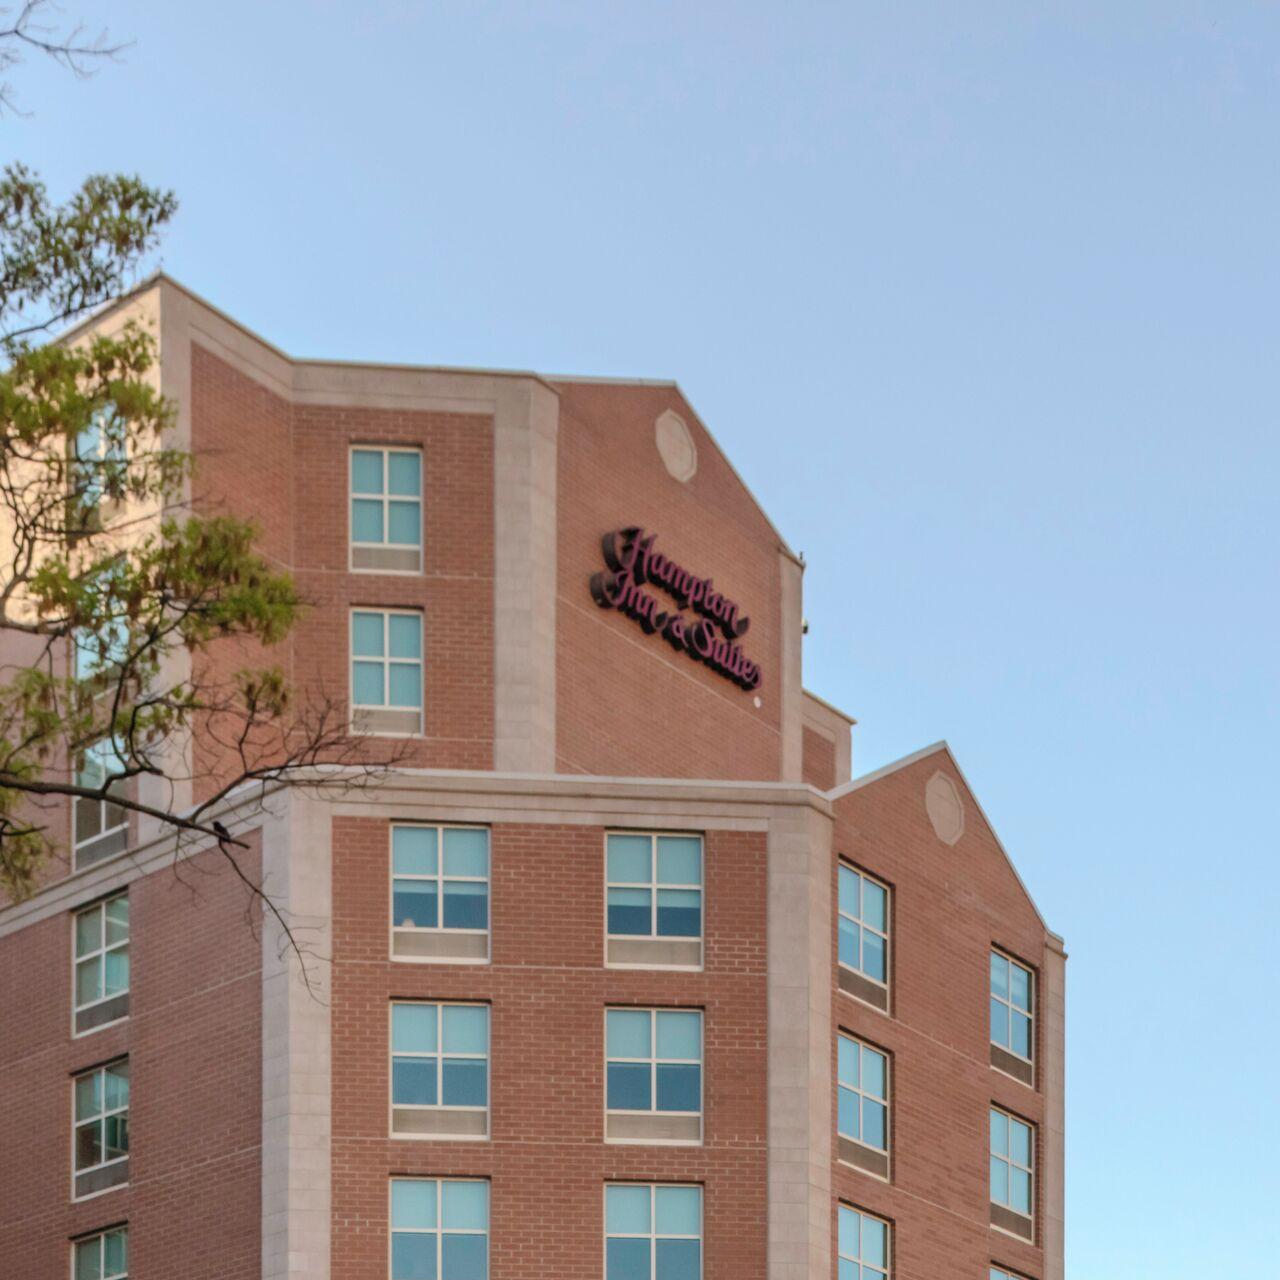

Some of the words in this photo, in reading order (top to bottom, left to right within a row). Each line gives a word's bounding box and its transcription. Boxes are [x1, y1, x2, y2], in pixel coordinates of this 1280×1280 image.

[590, 569, 669, 635] Inn
[686, 618, 763, 691] Suites
[602, 527, 750, 639] Hampton
